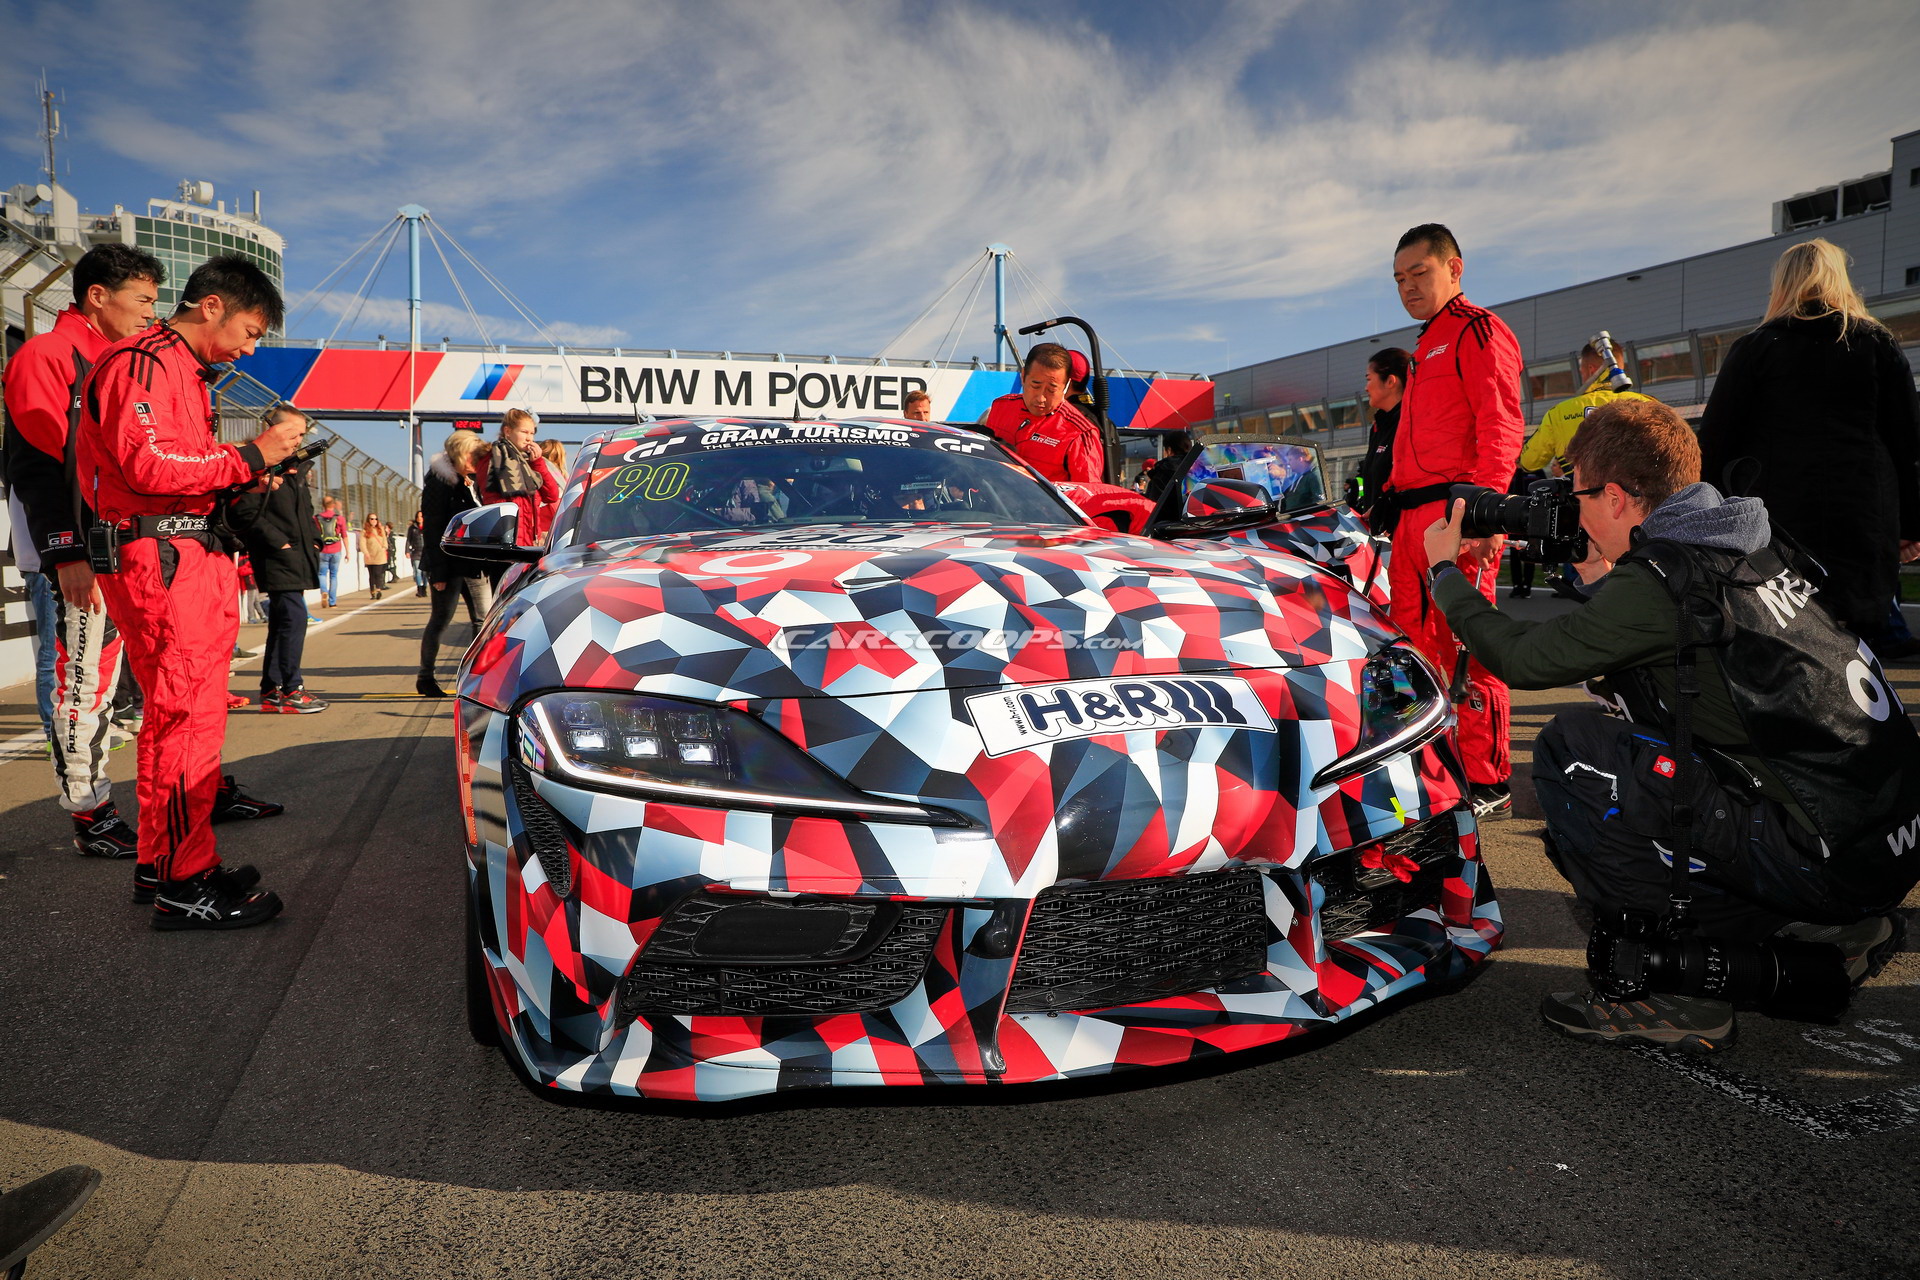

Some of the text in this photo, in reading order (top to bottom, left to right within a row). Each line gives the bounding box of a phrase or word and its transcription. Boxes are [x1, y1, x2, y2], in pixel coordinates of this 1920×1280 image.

[580, 365, 928, 411] BMW M POWER
[135, 403, 150, 425] GR
[700, 427, 780, 445] GRAN
[835, 438, 911, 447] SIMULATOR
[607, 461, 691, 504] 90
[156, 515, 209, 535] alpines
[49, 533, 73, 547] GR
[759, 533, 905, 544] 90
[76, 608, 89, 663] TOYOTA
[1019, 682, 1170, 731] H&R
[66, 708, 79, 754] Racing
